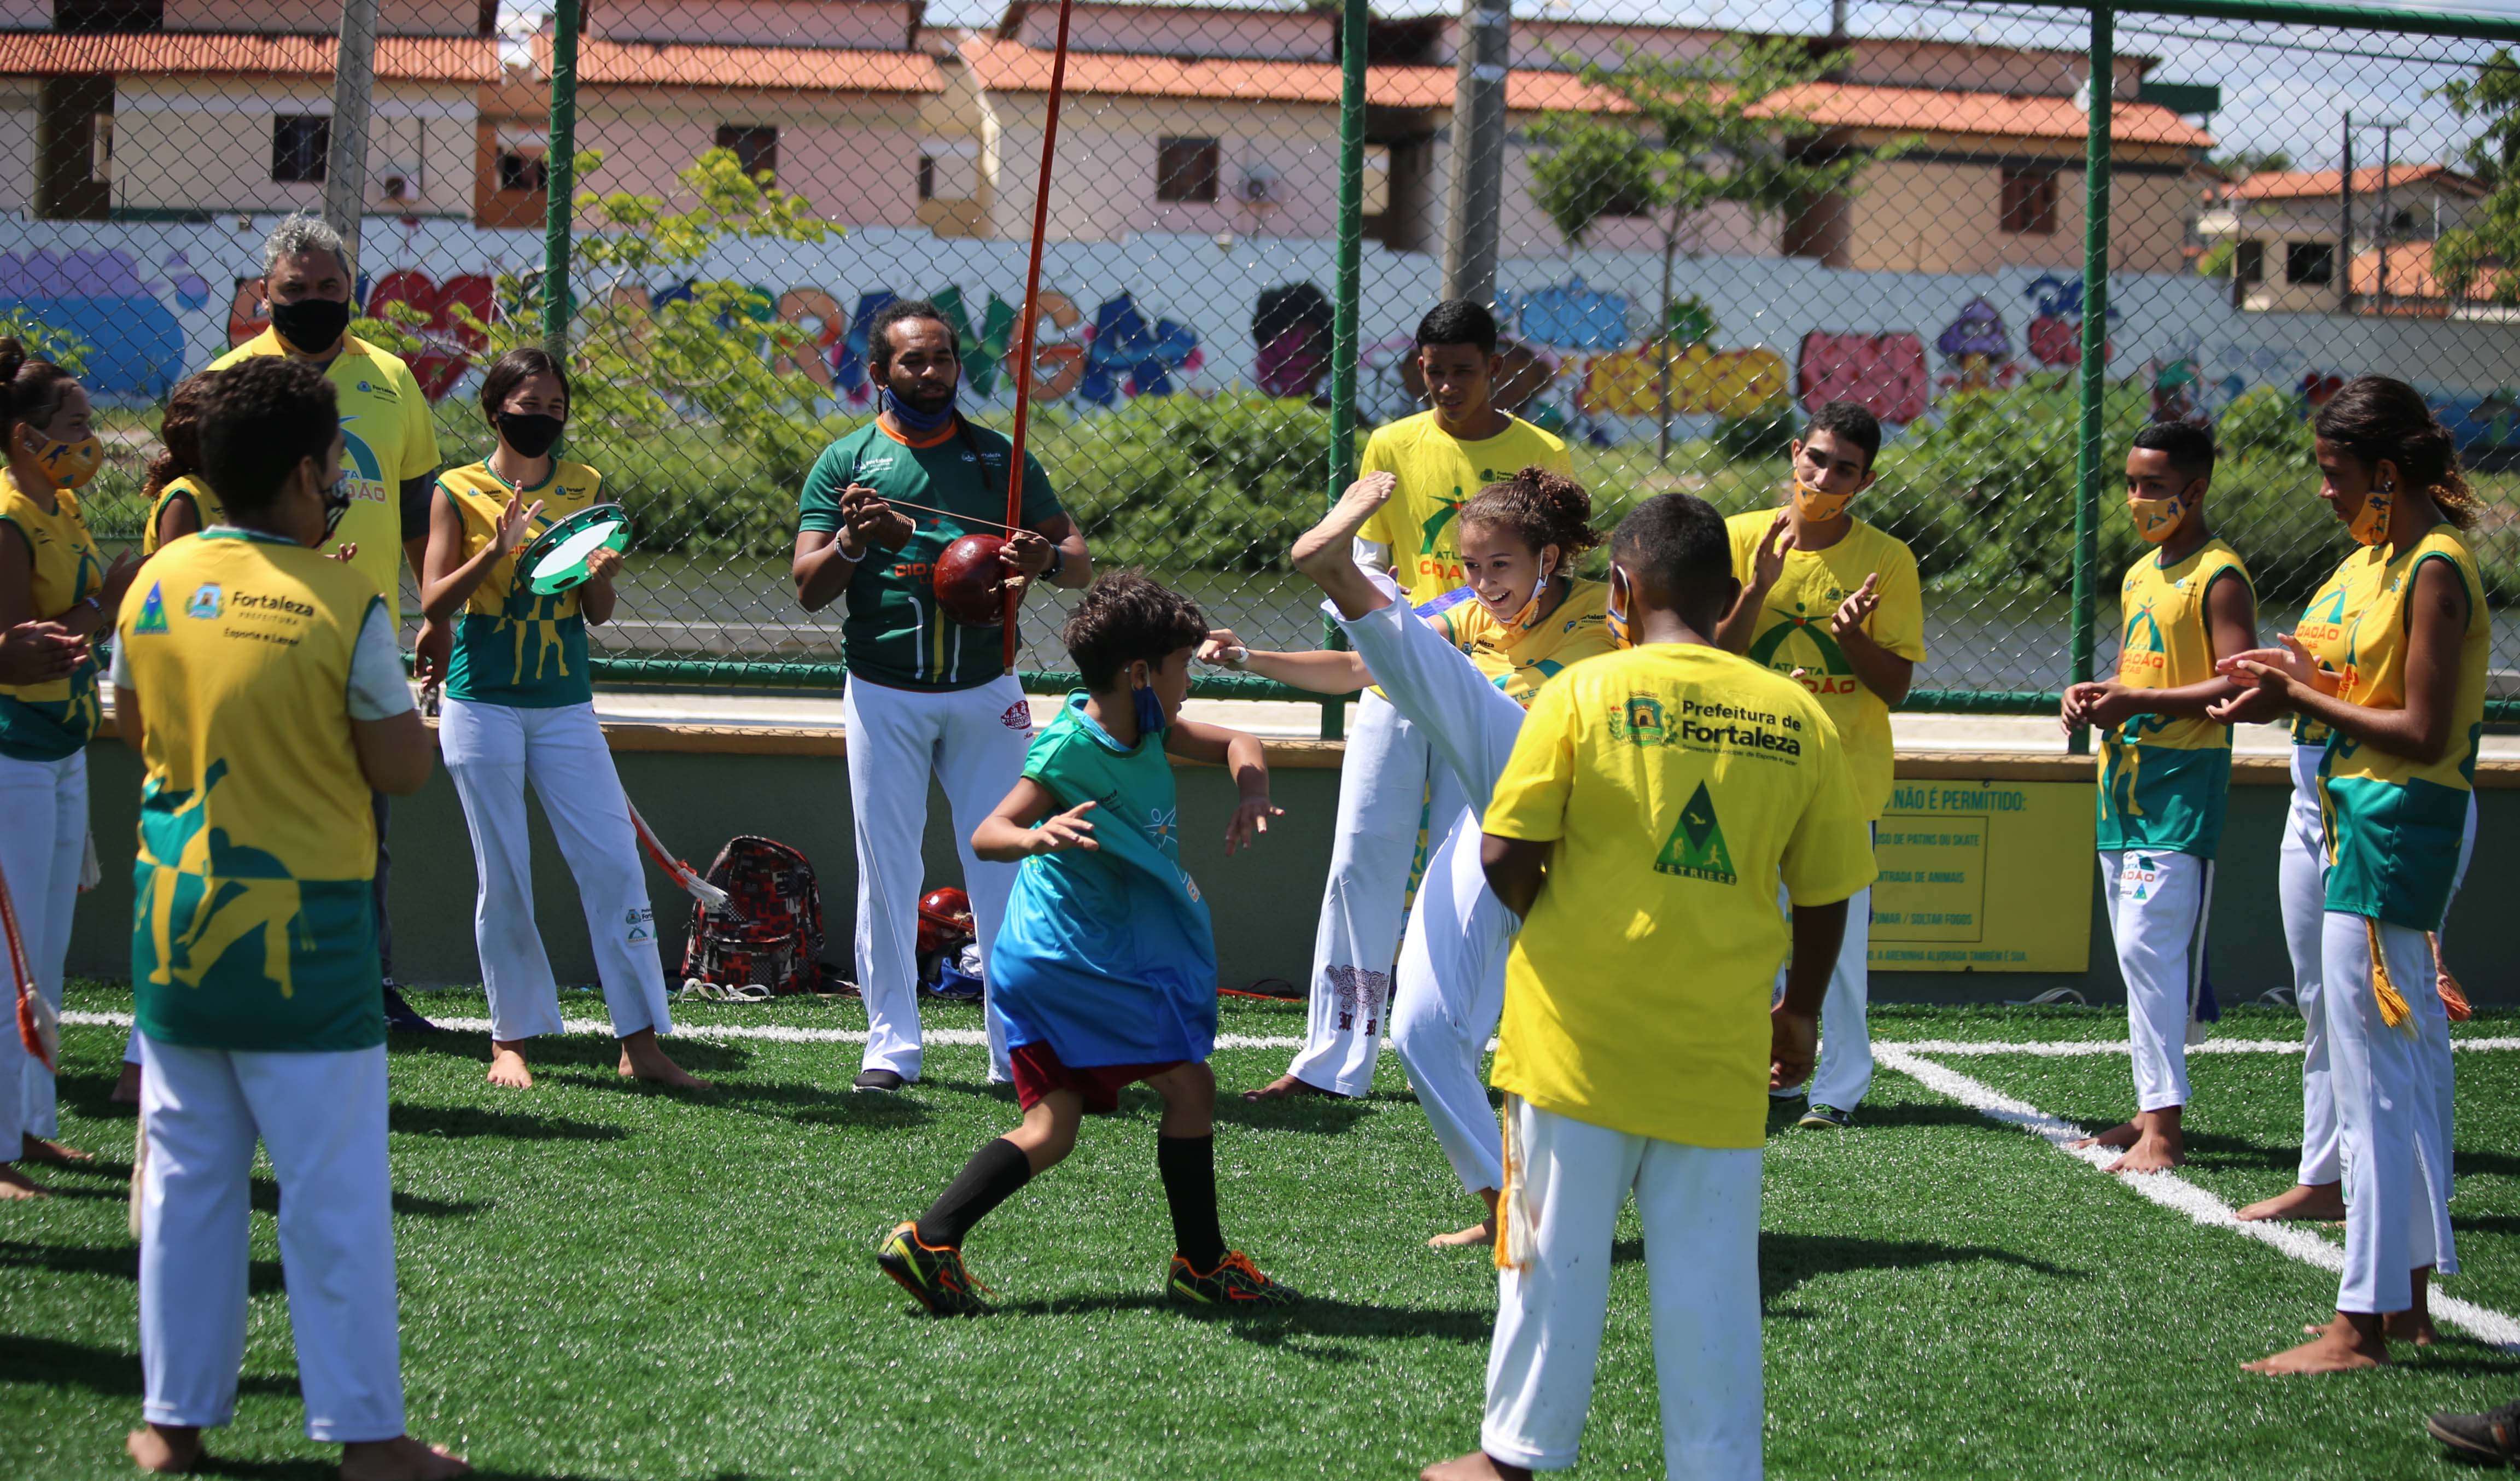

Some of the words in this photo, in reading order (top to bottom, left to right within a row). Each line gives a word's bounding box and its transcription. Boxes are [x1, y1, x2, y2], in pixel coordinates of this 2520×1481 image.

[1436, 551, 1462, 559] ATL
[1420, 560, 1463, 580] CIDA
[231, 591, 314, 617] Fortaleza
[238, 611, 299, 626] PREFEITURA
[224, 627, 261, 642] Esporte
[1683, 701, 1776, 725] Prefeitura
[1782, 715, 1801, 731] de
[1683, 720, 1801, 756] Fortaleza
[1714, 747, 1743, 756] Municipal
[1756, 753, 1778, 762] Esporte
[1894, 786, 1925, 809] NÃO
[1929, 786, 1937, 809] É
[1942, 790, 2027, 811] PERMITIDO:
[1894, 834, 1904, 844] DE
[1908, 834, 1936, 845] PATINS
[1939, 835, 1951, 846] OU
[1953, 835, 1980, 846] SKATE
[1656, 863, 1736, 885] FETRIECE
[1915, 872, 1926, 883] DE
[1928, 872, 1965, 883] ANIMAIS
[1911, 913, 1943, 925] SOLTAR
[1945, 914, 1973, 925] FOGOS
[1885, 951, 1925, 961] ARENINHA
[1969, 951, 2002, 961] TAMBÉM
